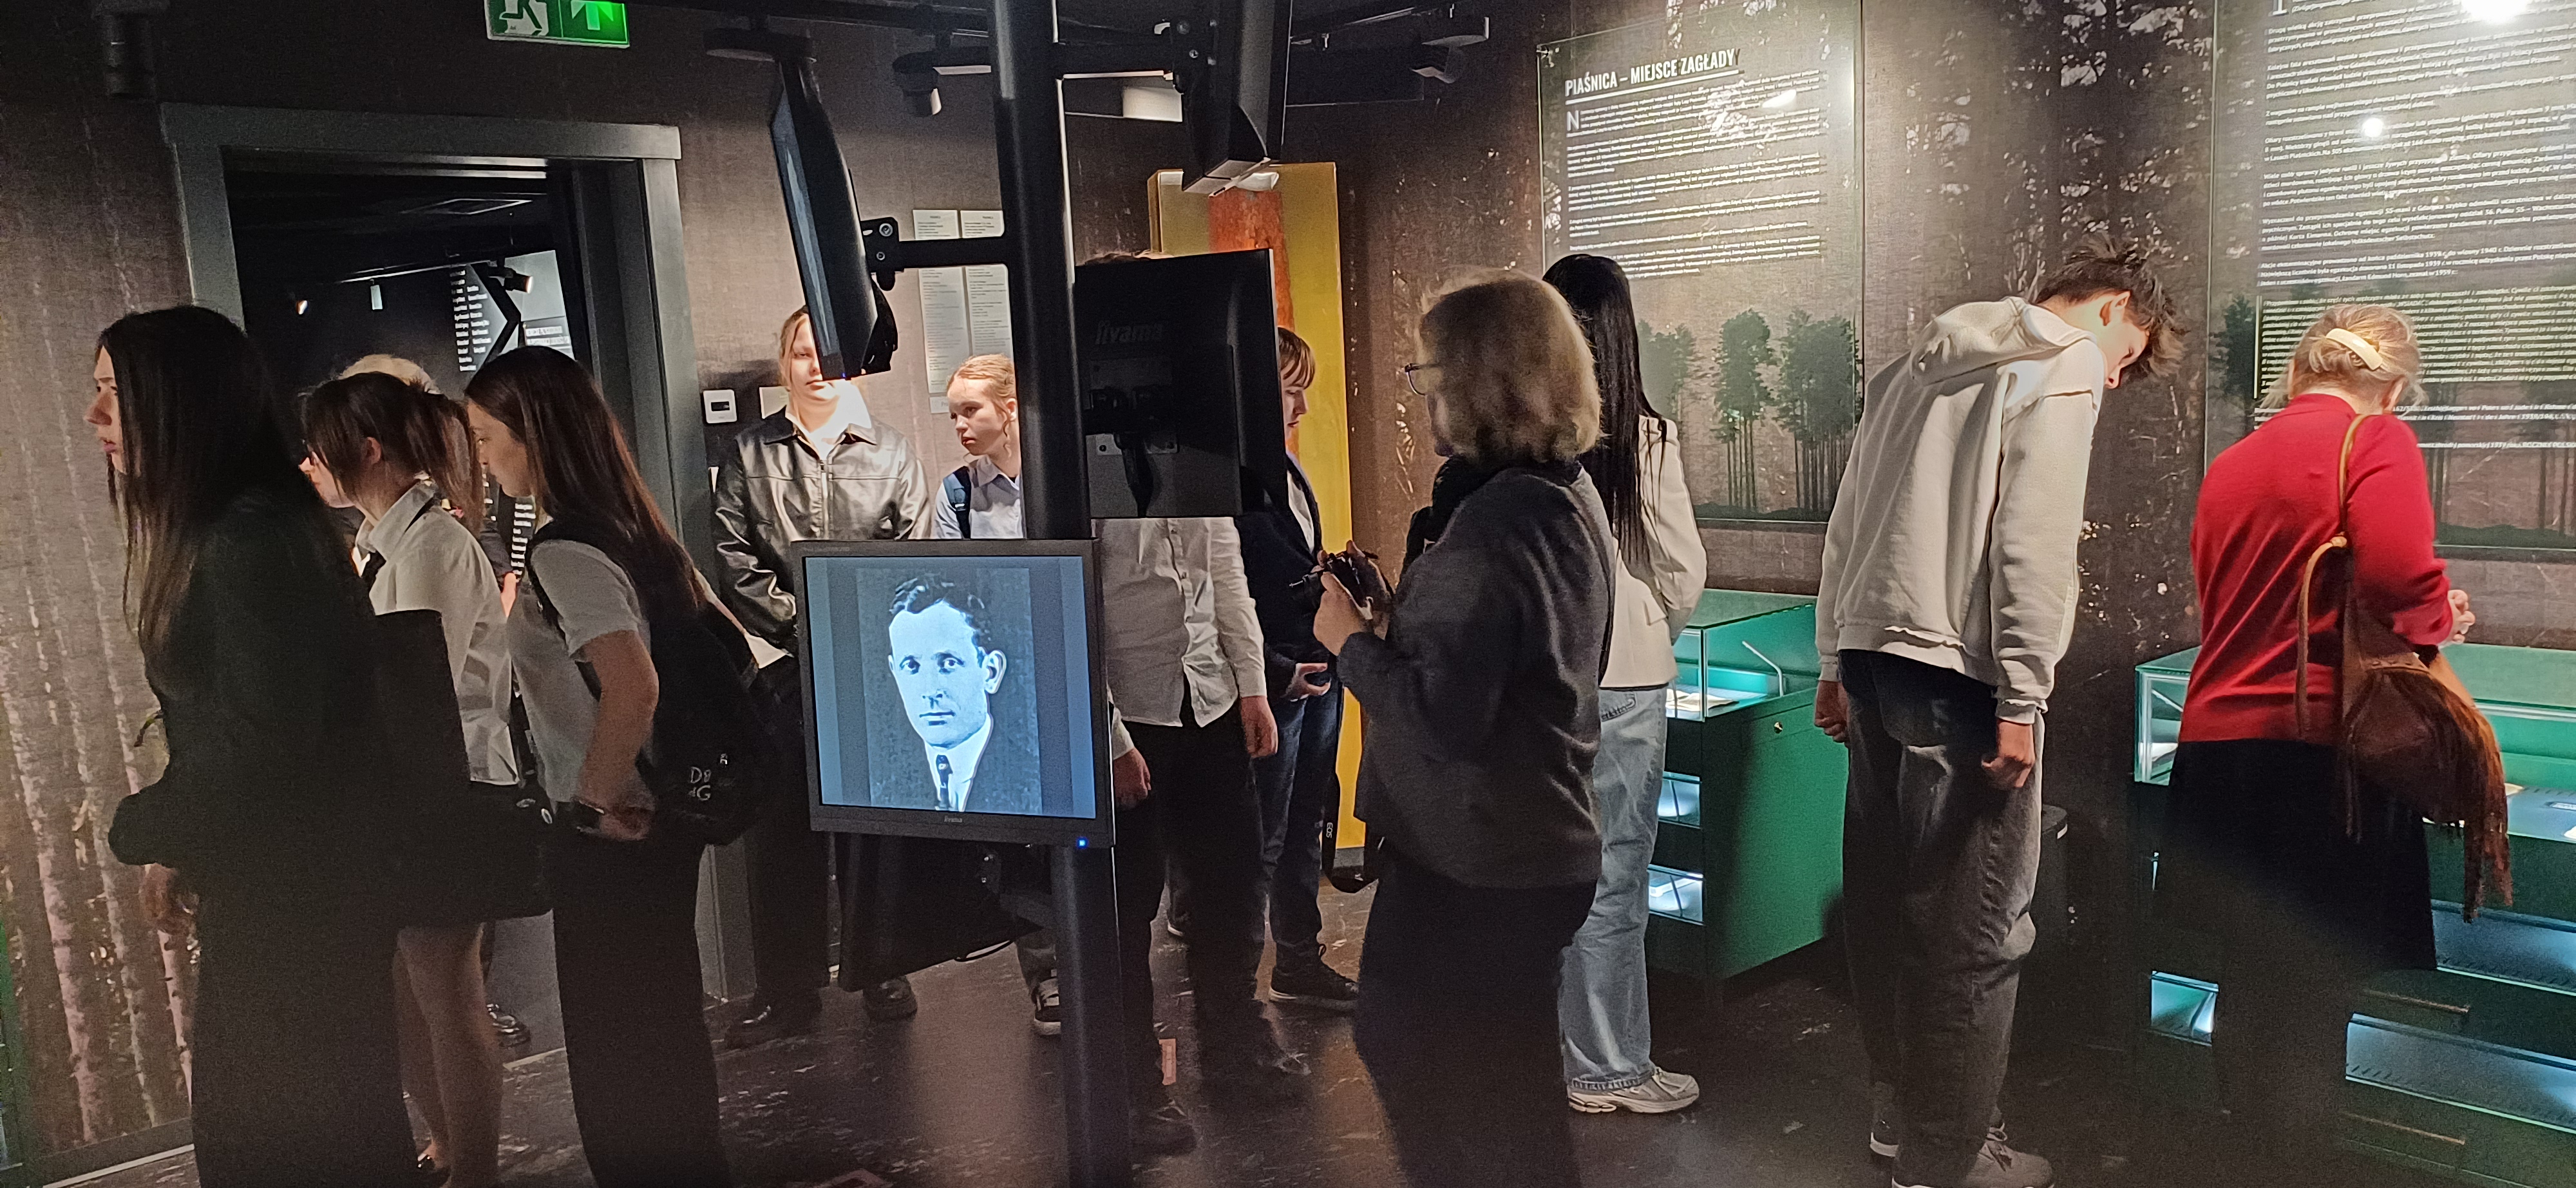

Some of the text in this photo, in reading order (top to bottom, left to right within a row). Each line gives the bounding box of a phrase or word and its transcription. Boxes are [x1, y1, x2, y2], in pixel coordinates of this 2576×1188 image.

[1565, 72, 1618, 97] PIAŚNICA
[1631, 60, 1678, 84] MIEJSCE
[1680, 48, 1735, 75] ZAGŁADY
